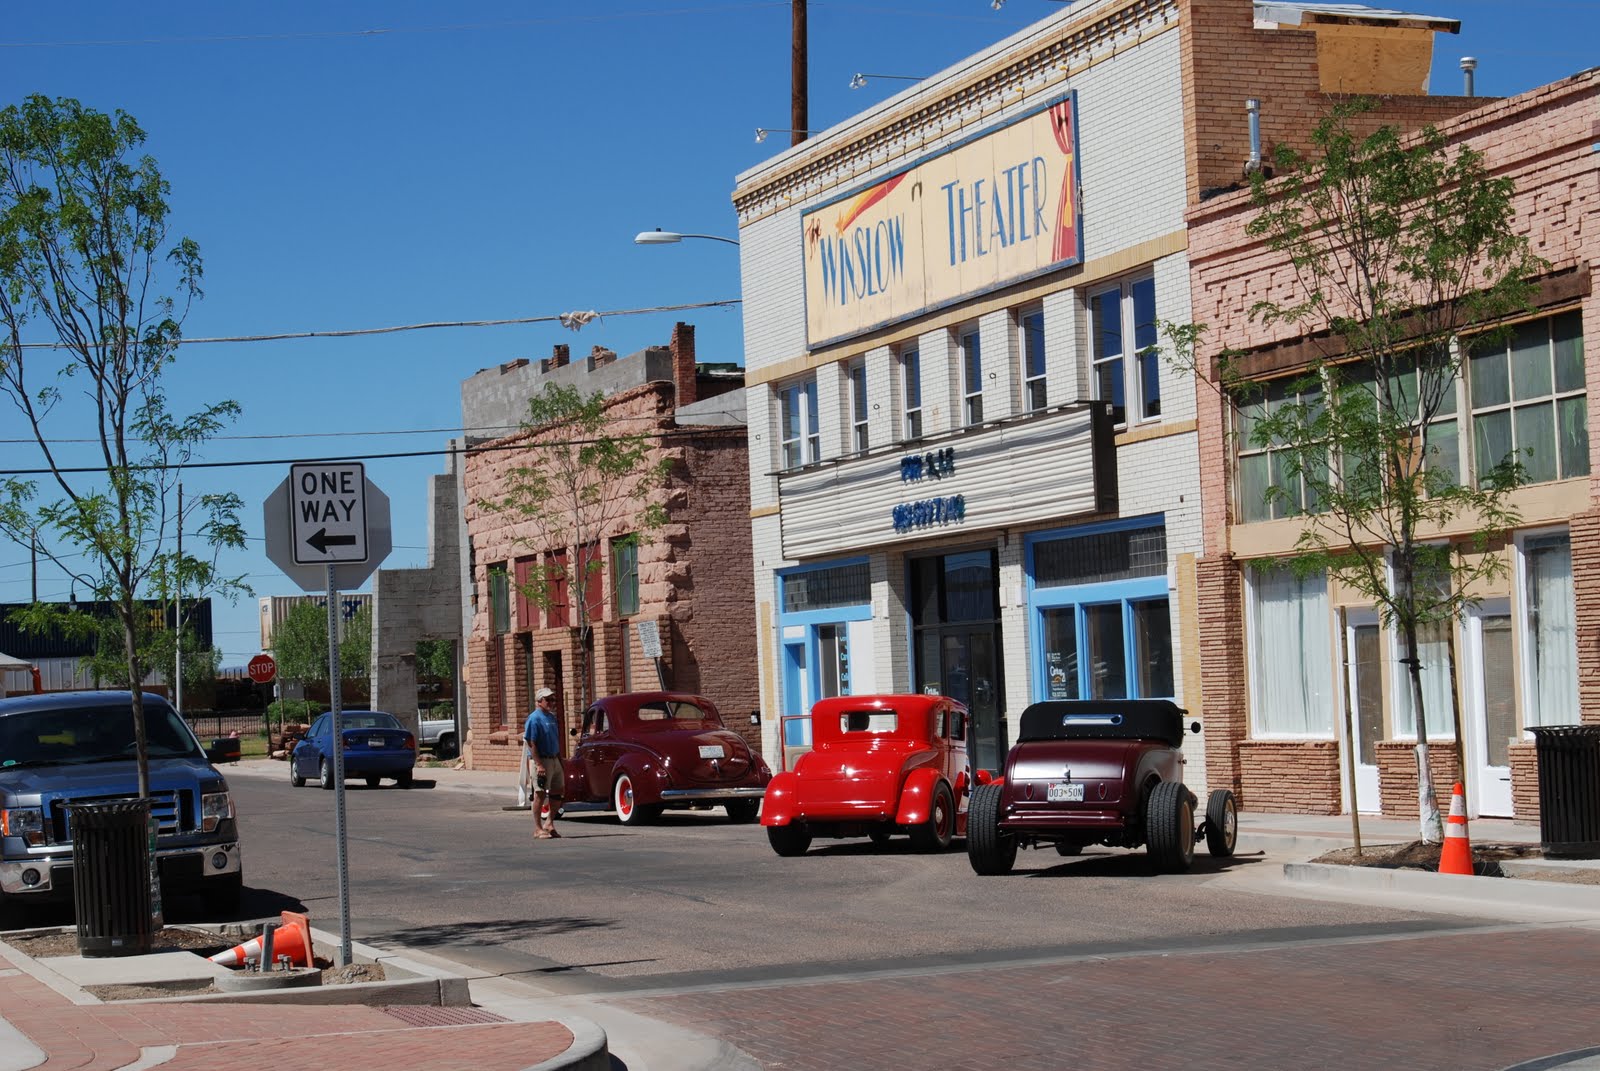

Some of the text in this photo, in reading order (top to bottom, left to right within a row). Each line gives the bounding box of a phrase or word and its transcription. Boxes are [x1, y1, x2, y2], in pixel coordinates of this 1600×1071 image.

[820, 156, 1049, 308] WINSLOW THEATER
[301, 471, 356, 495] ONE
[300, 499, 357, 523] WAY
[250, 662, 274, 675] STOP
